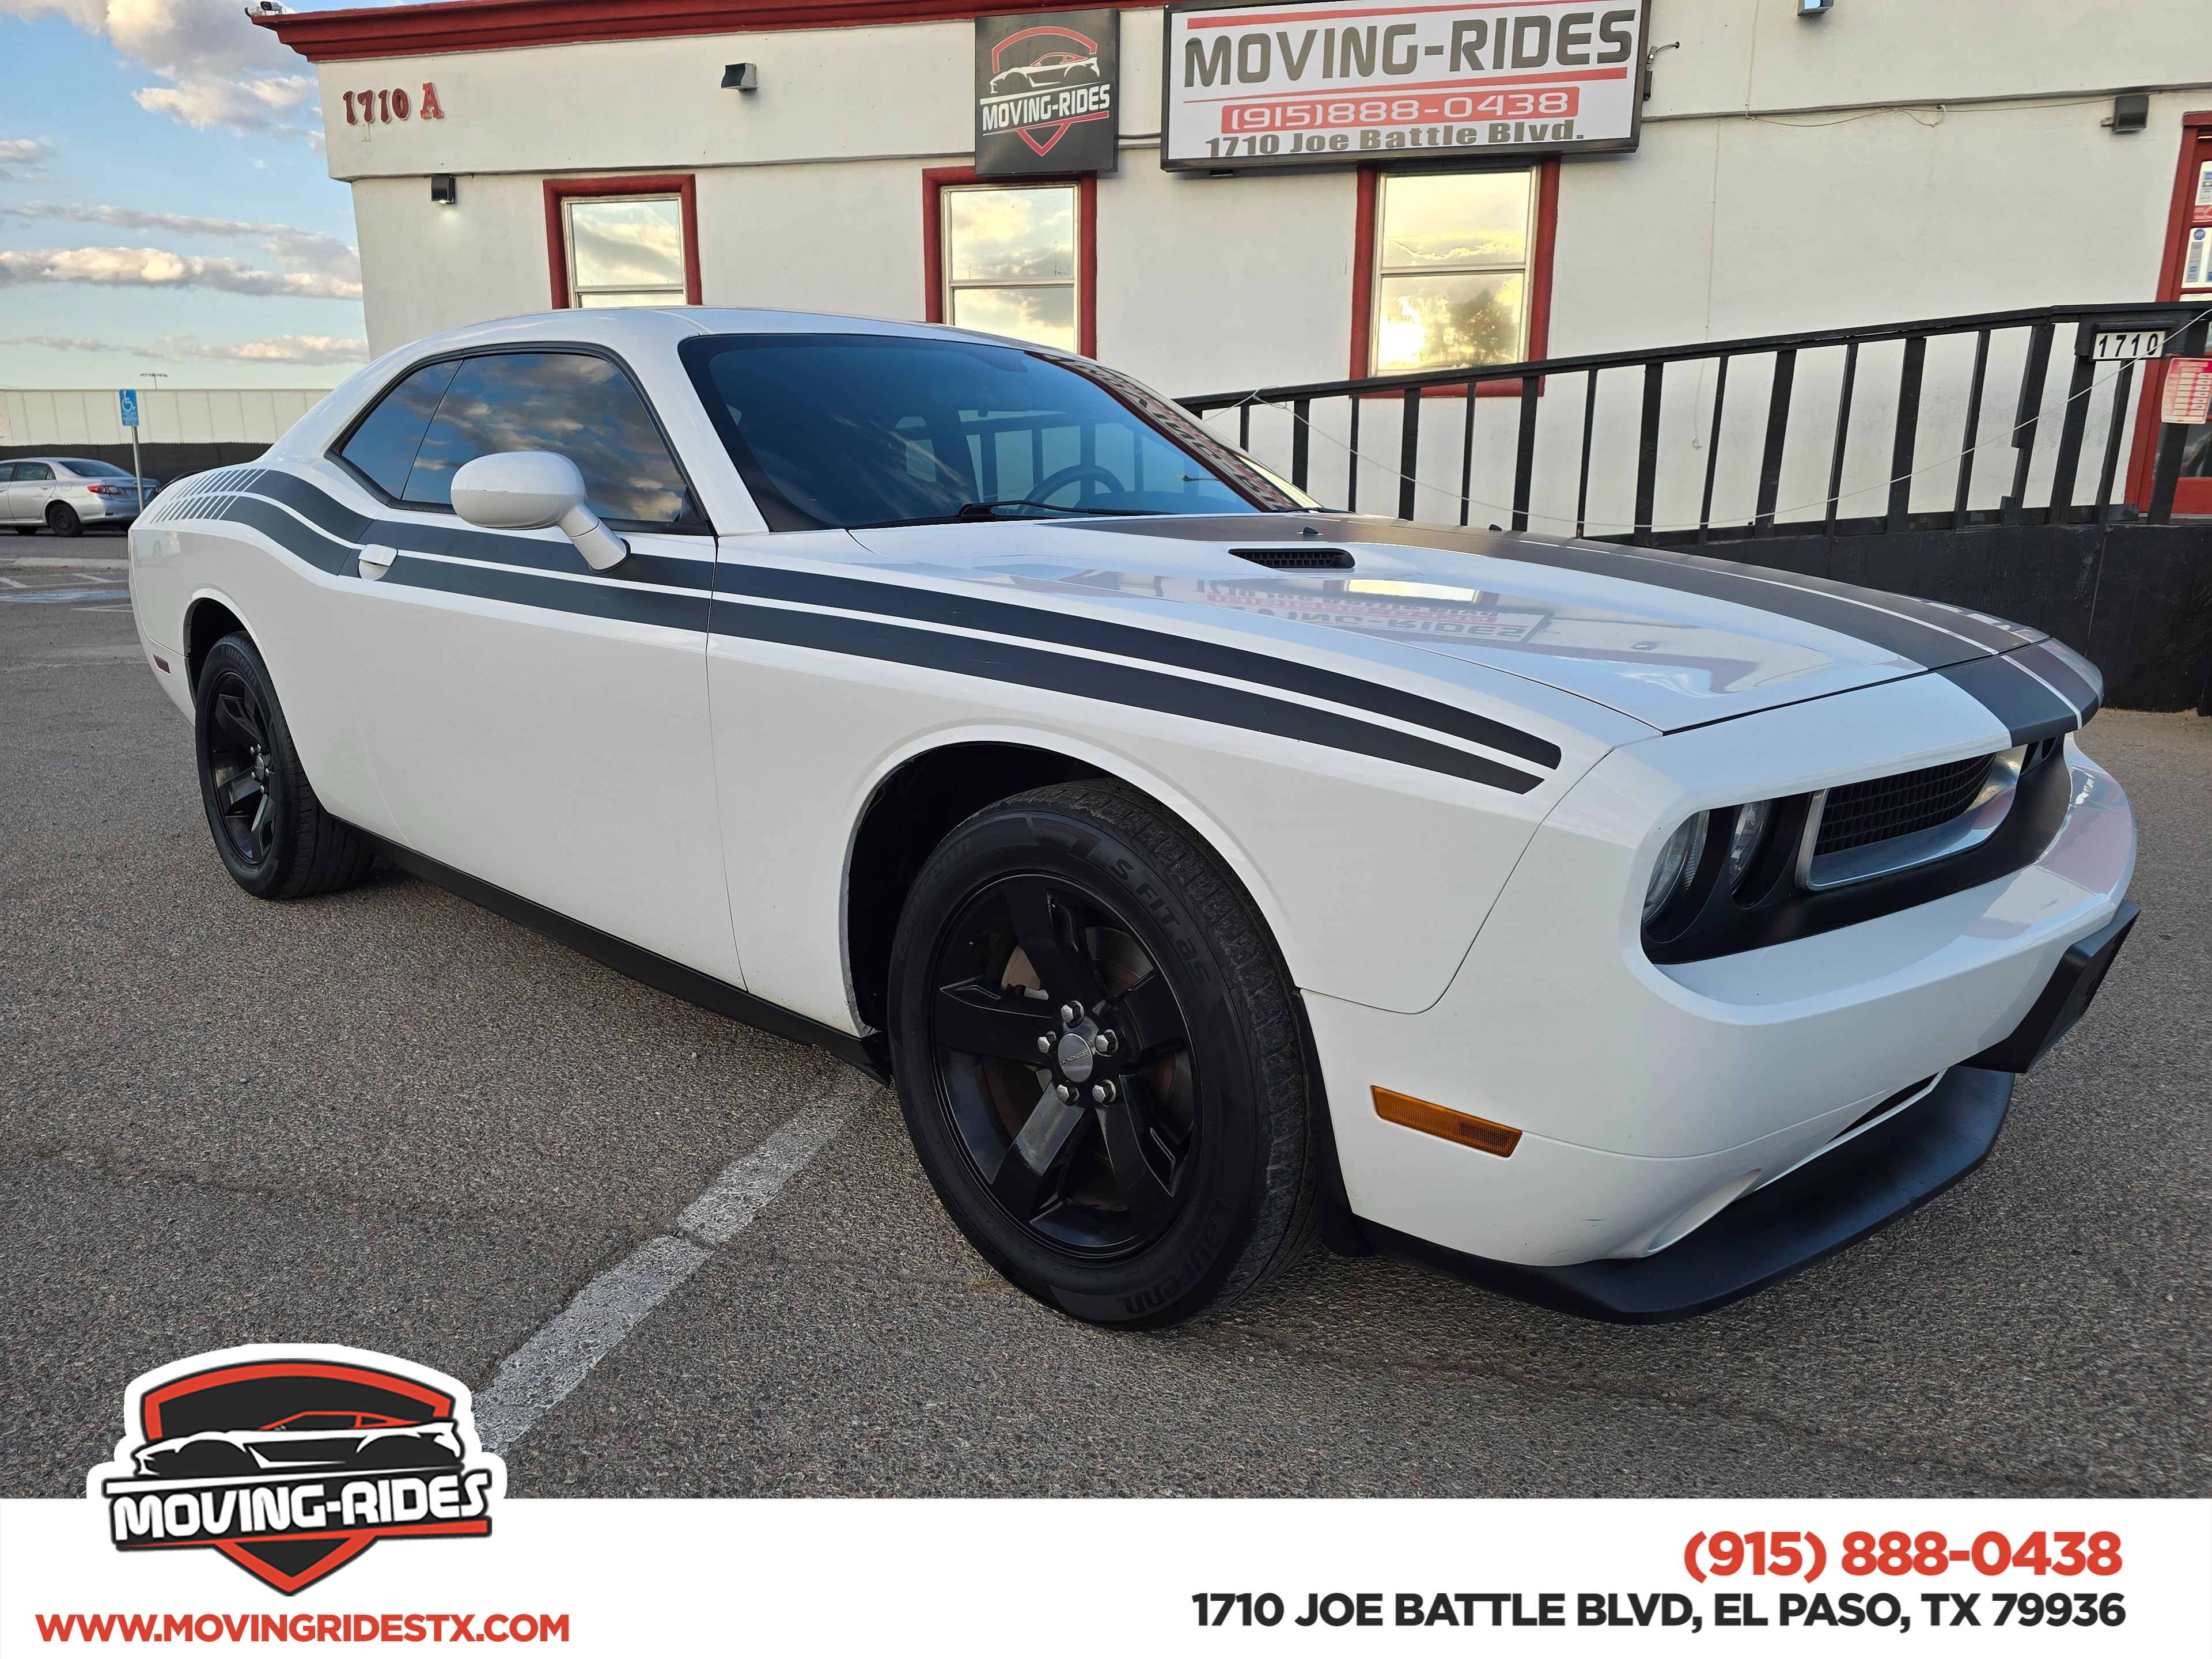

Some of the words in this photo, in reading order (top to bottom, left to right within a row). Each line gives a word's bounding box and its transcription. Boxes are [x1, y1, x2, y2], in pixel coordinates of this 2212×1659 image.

[1184, 9, 1636, 88] MOVING-RIDES
[343, 88, 411, 125] 1710
[420, 81, 444, 119] A
[983, 84, 1111, 131] MOVING-RIDES
[1232, 92, 1568, 130] (915)888-0438
[1206, 134, 1279, 157] 1710
[1290, 132, 1349, 153] Joe
[1359, 125, 1478, 149] Battle
[1488, 119, 1584, 143] Blvd.
[2099, 333, 2158, 357] 1710
[1060, 1050, 1090, 1066] DODGE
